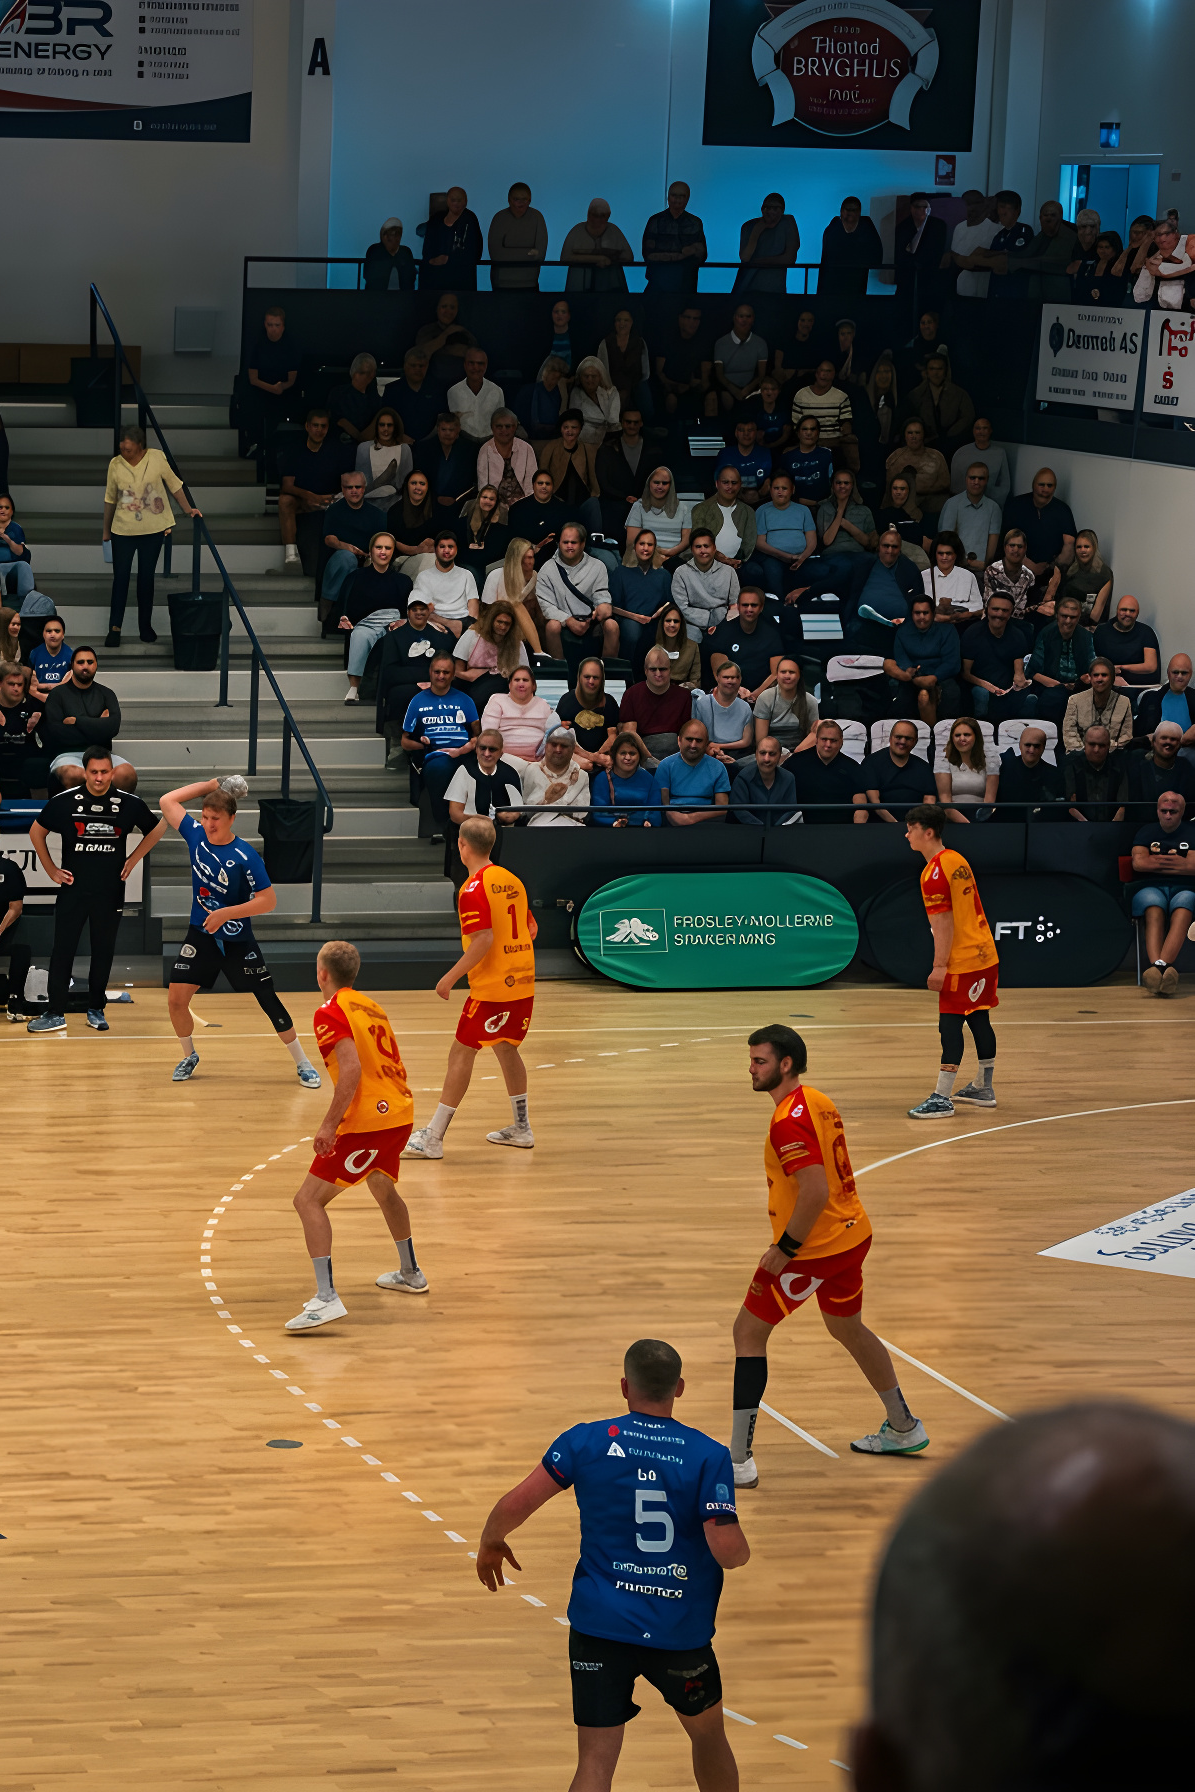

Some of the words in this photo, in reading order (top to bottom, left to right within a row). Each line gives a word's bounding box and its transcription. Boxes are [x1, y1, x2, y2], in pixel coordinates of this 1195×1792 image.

[307, 38, 331, 76] A
[792, 56, 902, 78] BRYGHUS
[634, 1488, 675, 1553] 5
